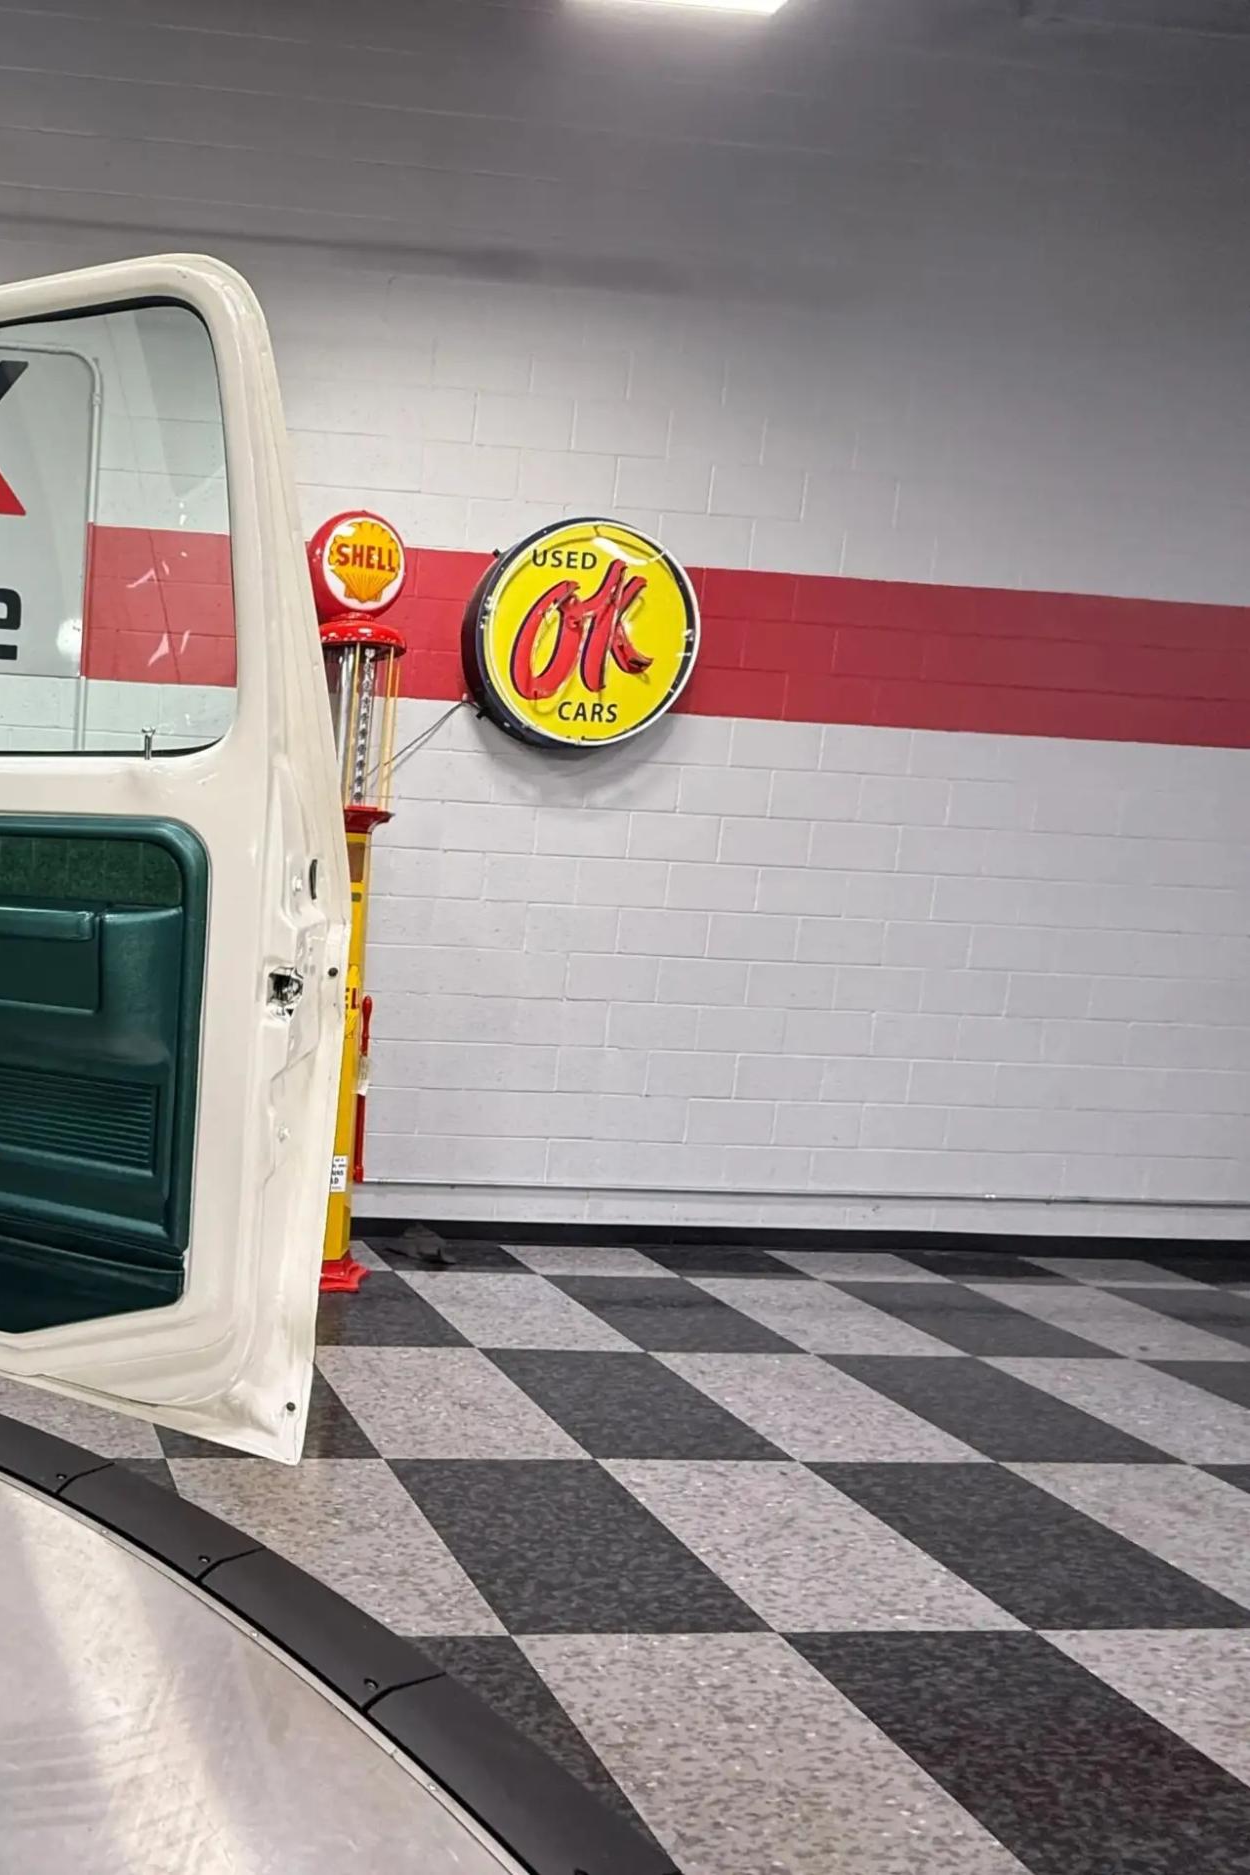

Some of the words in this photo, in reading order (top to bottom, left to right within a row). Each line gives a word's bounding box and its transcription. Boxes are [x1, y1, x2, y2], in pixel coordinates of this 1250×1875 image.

[335, 542, 396, 573] SHELL
[532, 548, 597, 570] USED
[510, 559, 653, 701] OK
[558, 701, 618, 723] CARS
